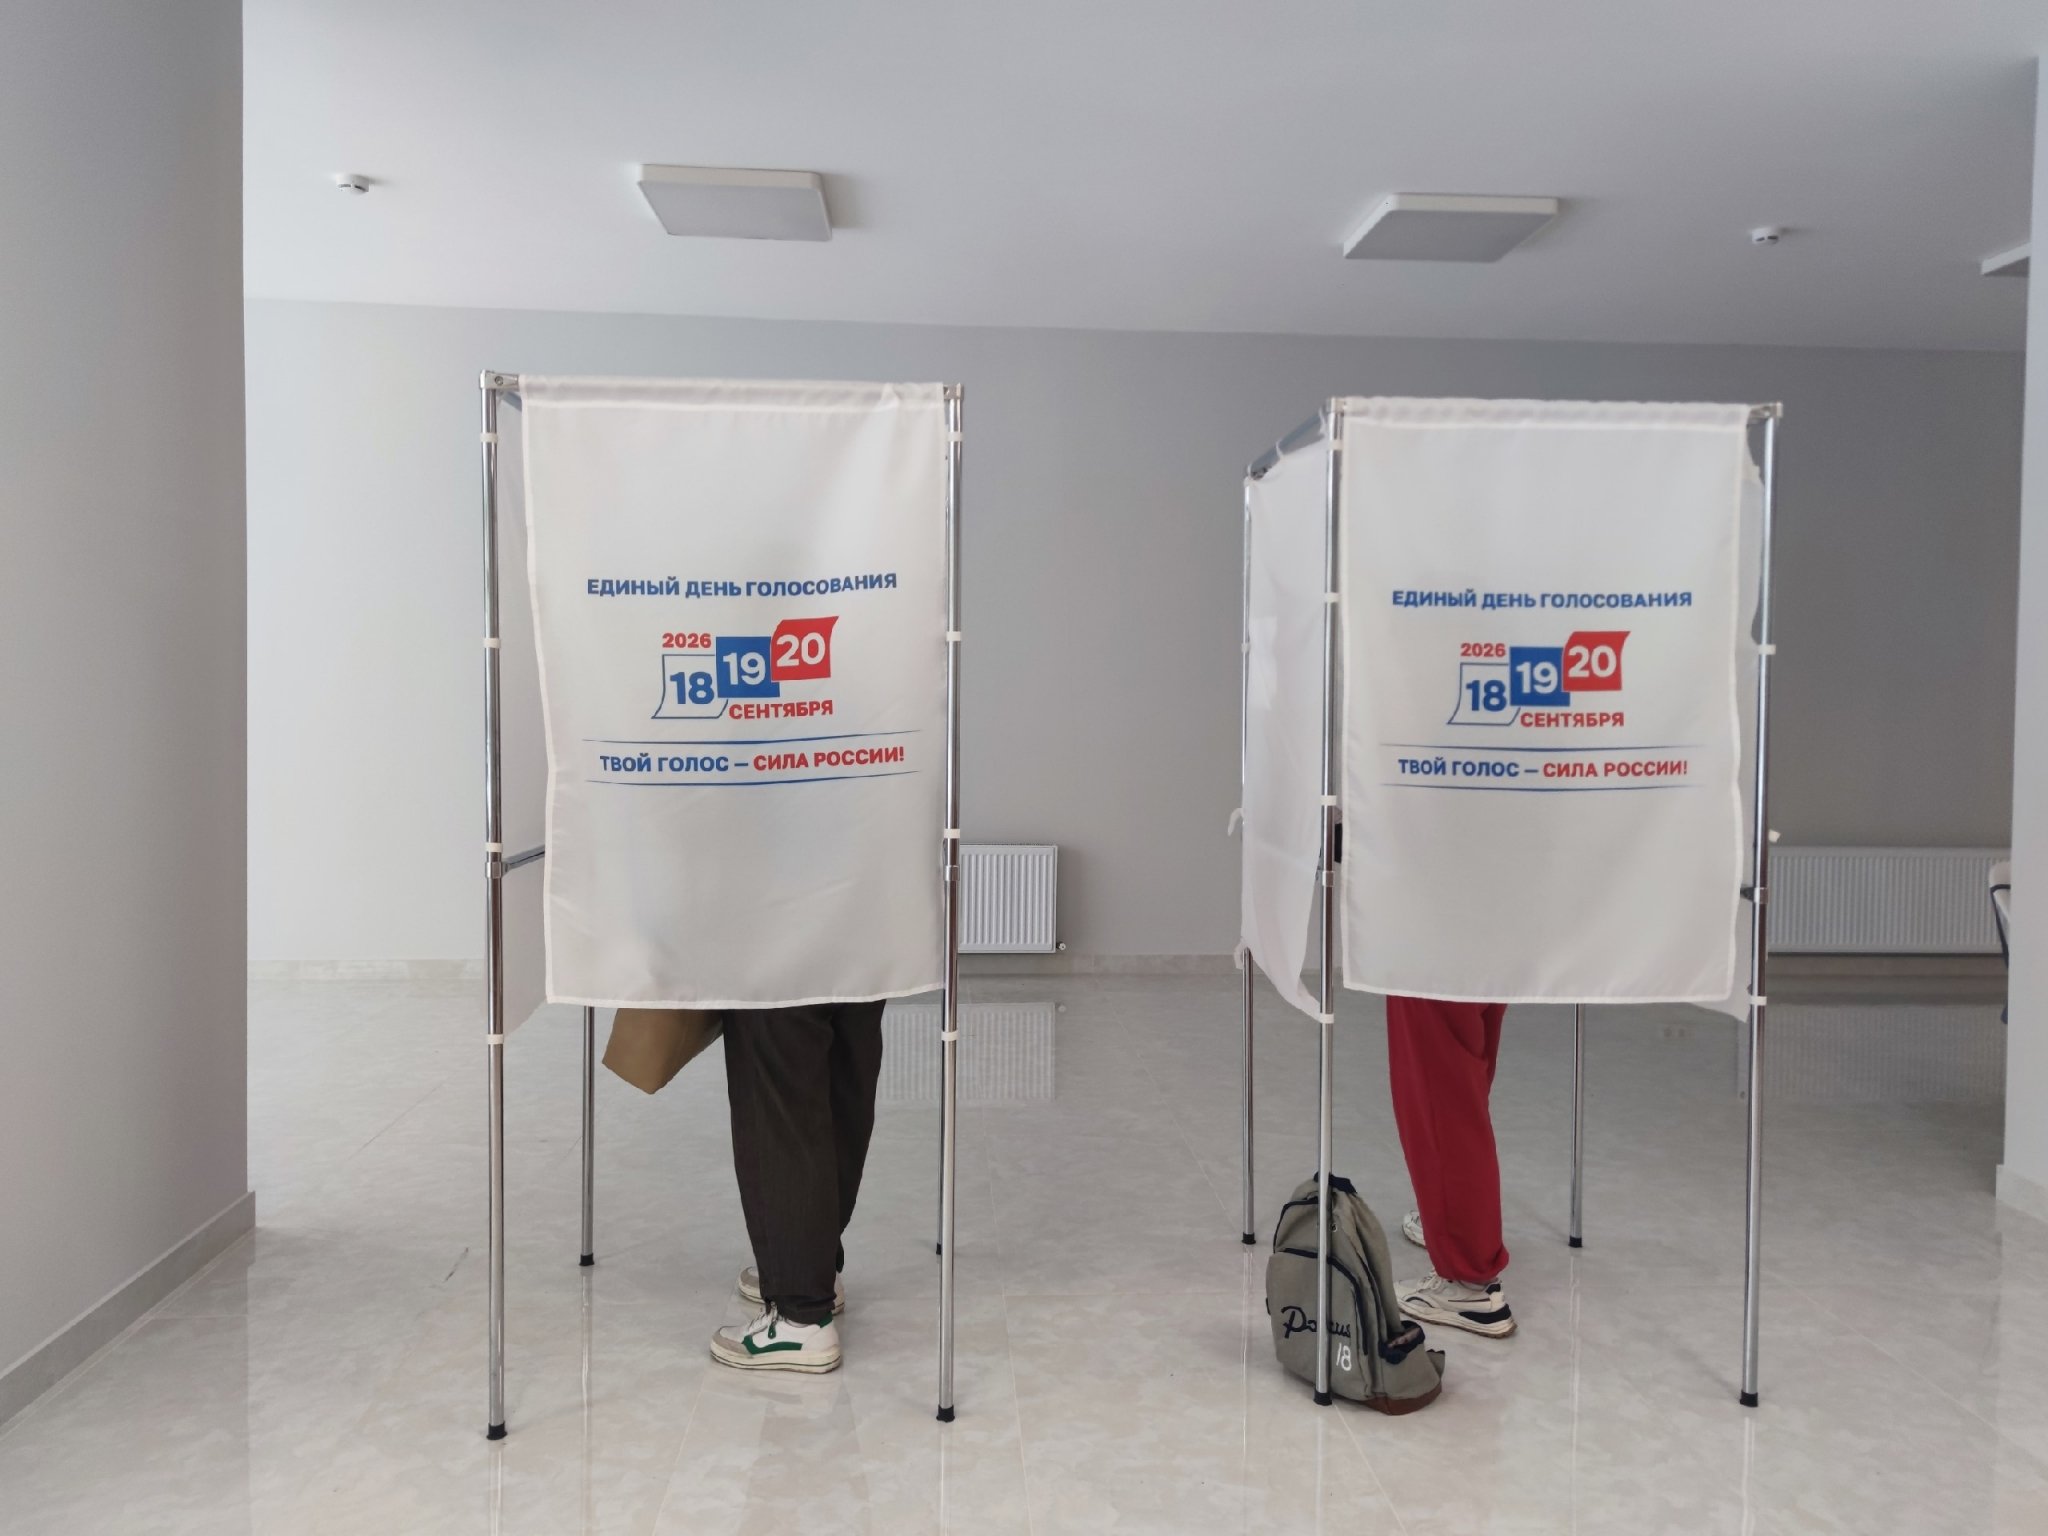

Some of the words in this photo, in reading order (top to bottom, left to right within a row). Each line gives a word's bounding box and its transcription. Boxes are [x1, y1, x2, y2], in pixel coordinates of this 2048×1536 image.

[587, 576, 680, 597] ЕДИНЫЙ
[685, 581, 742, 598] ДЕНЬ
[746, 573, 898, 597] ГОЛОСОВАНИЯ
[1392, 589, 1477, 608] ЕДИНЫЙ
[1481, 592, 1537, 610] ДЕНЬ
[1540, 591, 1693, 609] ГОЛОСОВАНИЯ
[662, 632, 712, 649] 2026
[1460, 642, 1507, 658] 2026
[669, 671, 715, 705] 18
[722, 652, 767, 686] 19
[776, 632, 826, 667] 20
[1465, 679, 1507, 712] 18
[1515, 662, 1559, 694] 19
[1567, 645, 1618, 678] 20
[728, 699, 834, 721] СЕНТЯБРЯ
[1519, 712, 1625, 728] СЕНТЯБРЯ
[600, 752, 652, 773] ТВОЙ
[657, 756, 729, 773] ГОЛОС
[752, 752, 809, 772] СИЛА
[813, 746, 905, 768] РОССИИ!
[1398, 757, 1447, 776] ТВОЙ
[1452, 761, 1520, 778] ГОЛОС
[1542, 762, 1598, 778] СИЛА
[1603, 760, 1688, 777] РОССИИ!
[1336, 1342, 1352, 1372] 18
